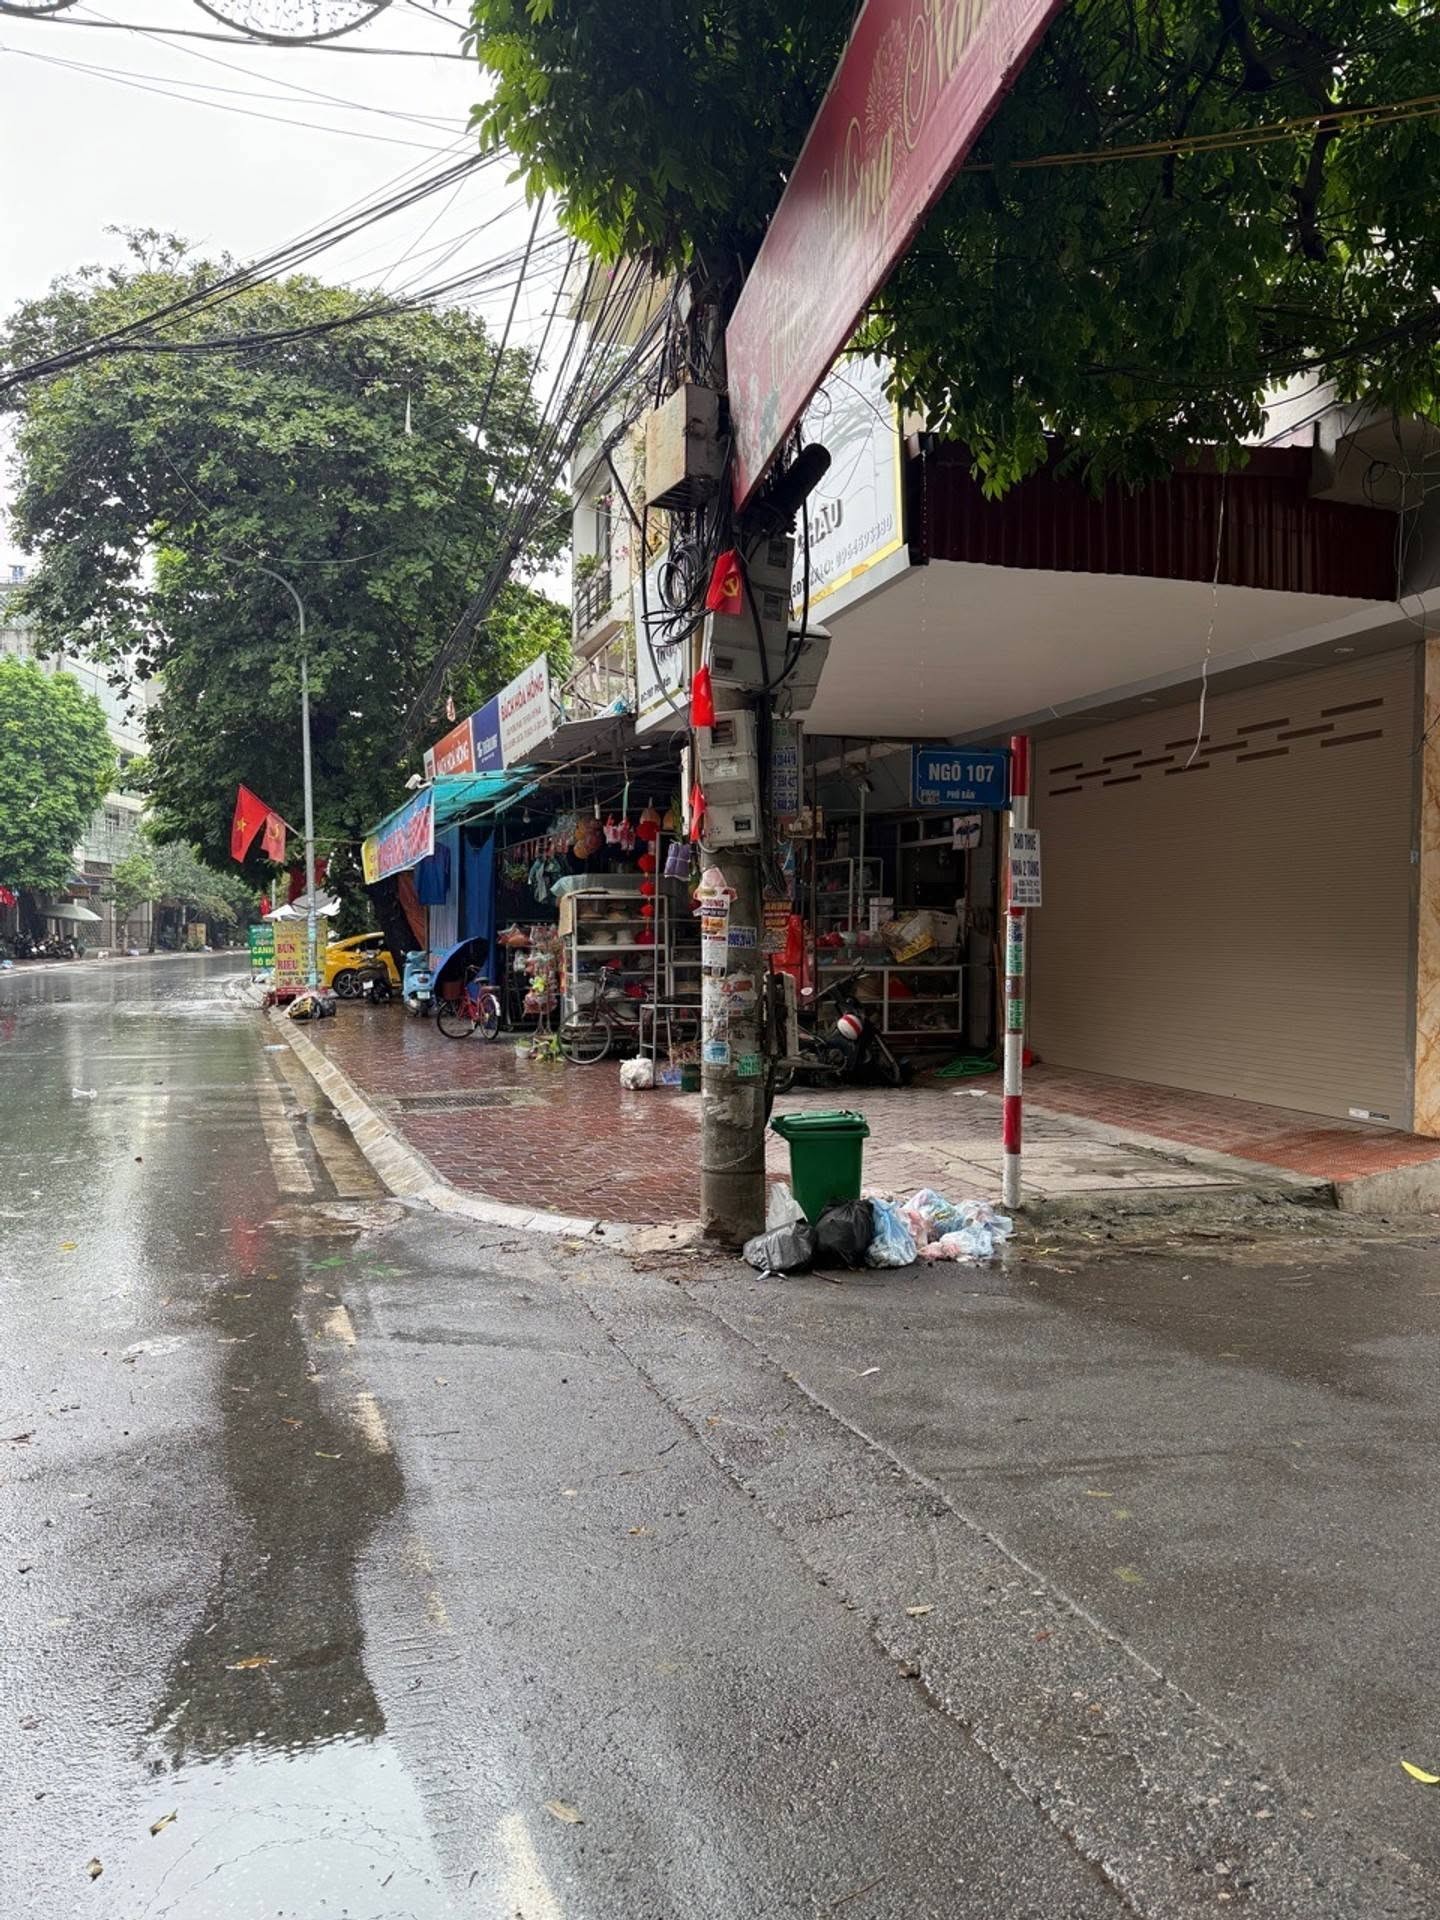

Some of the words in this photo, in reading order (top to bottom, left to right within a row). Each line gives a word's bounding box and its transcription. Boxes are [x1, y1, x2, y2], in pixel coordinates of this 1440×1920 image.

[928, 760, 961, 781] NGÕ
[967, 764, 994, 783] 107
[1022, 860, 1027, 877] 2
